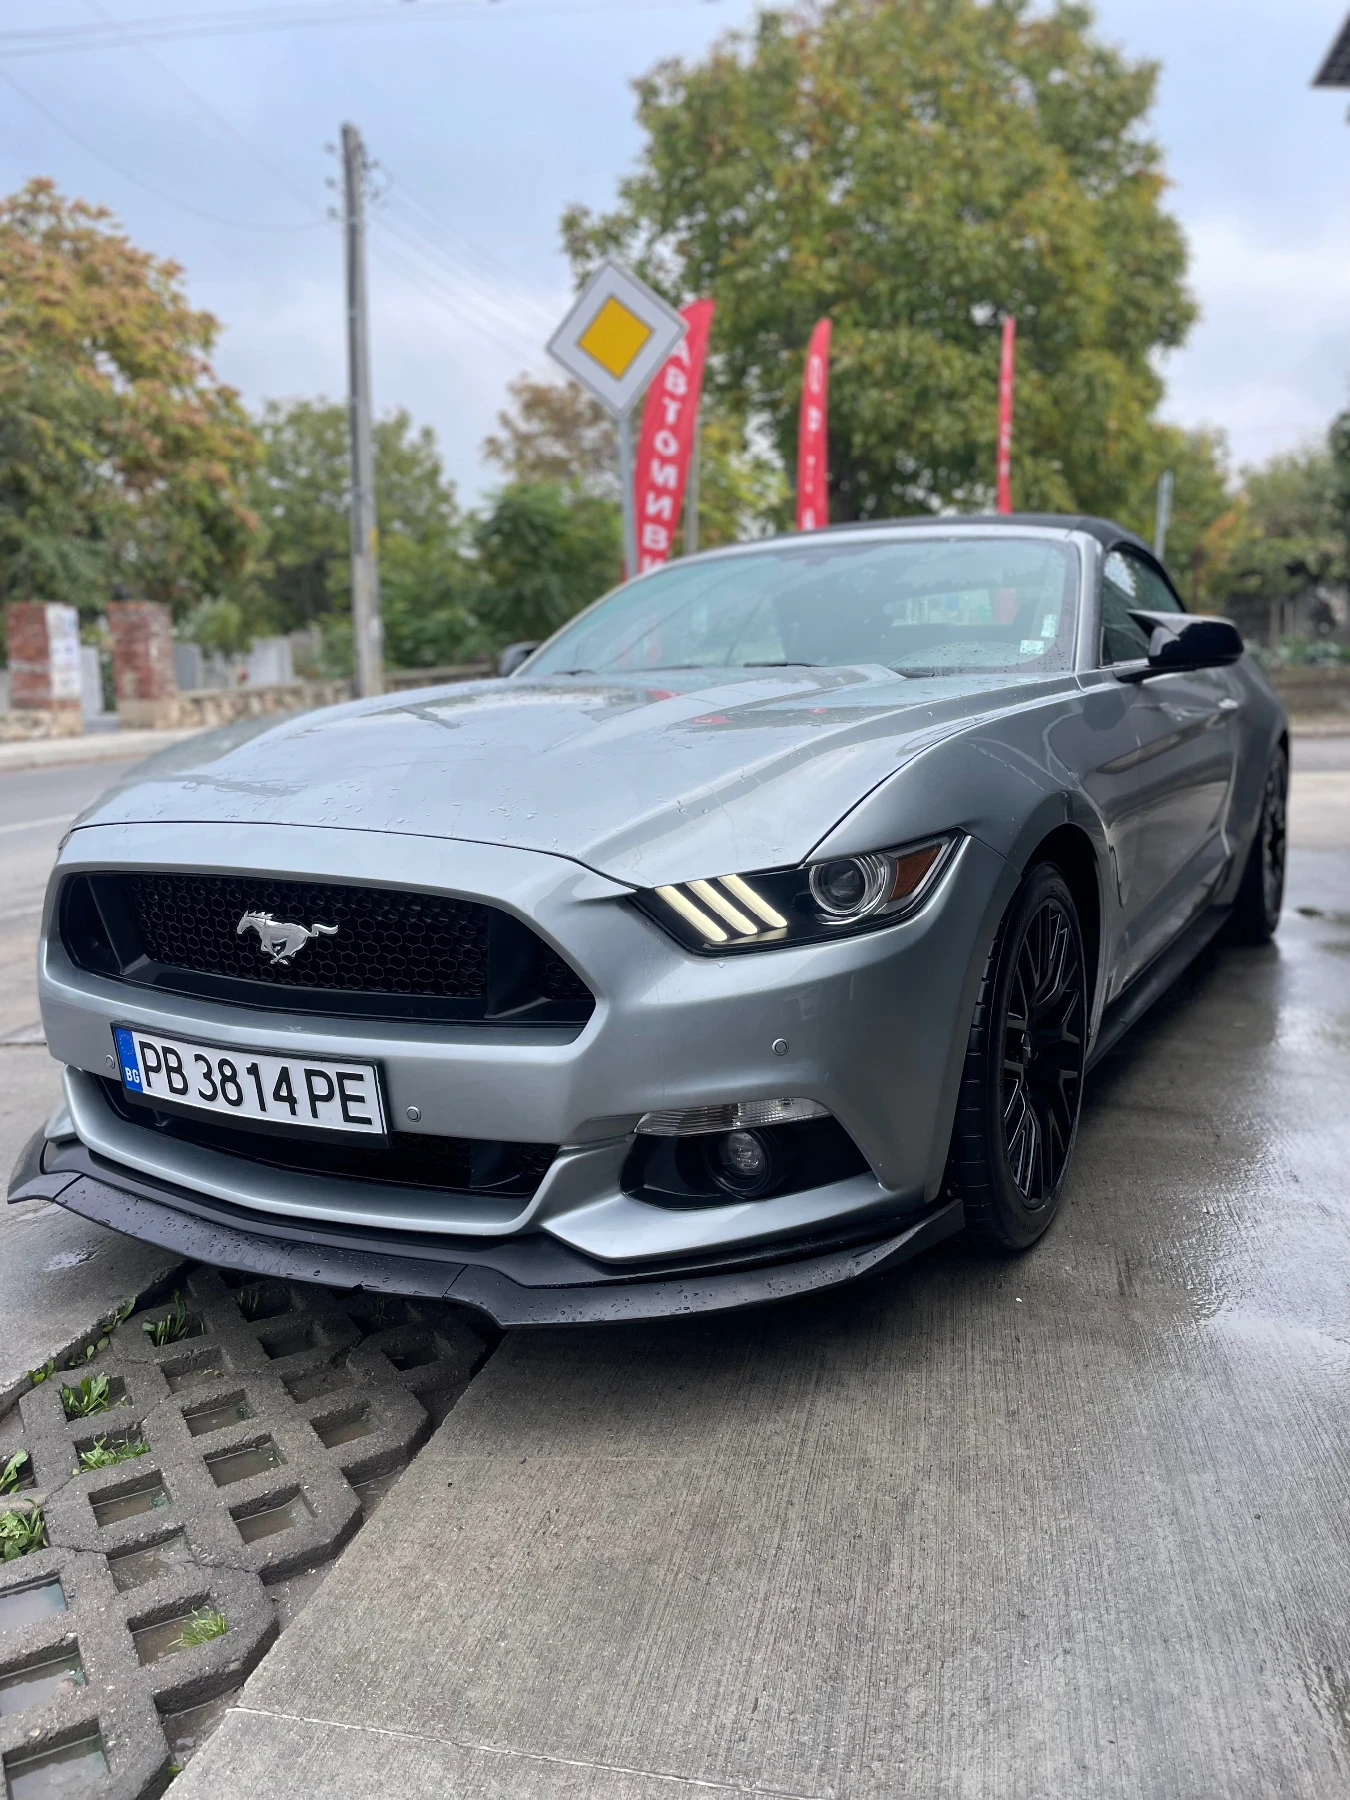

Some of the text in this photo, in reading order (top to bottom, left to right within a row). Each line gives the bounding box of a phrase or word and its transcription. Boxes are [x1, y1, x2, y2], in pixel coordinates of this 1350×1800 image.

[125, 1066, 140, 1083] BG
[138, 1040, 373, 1125] PB 3814 PE
